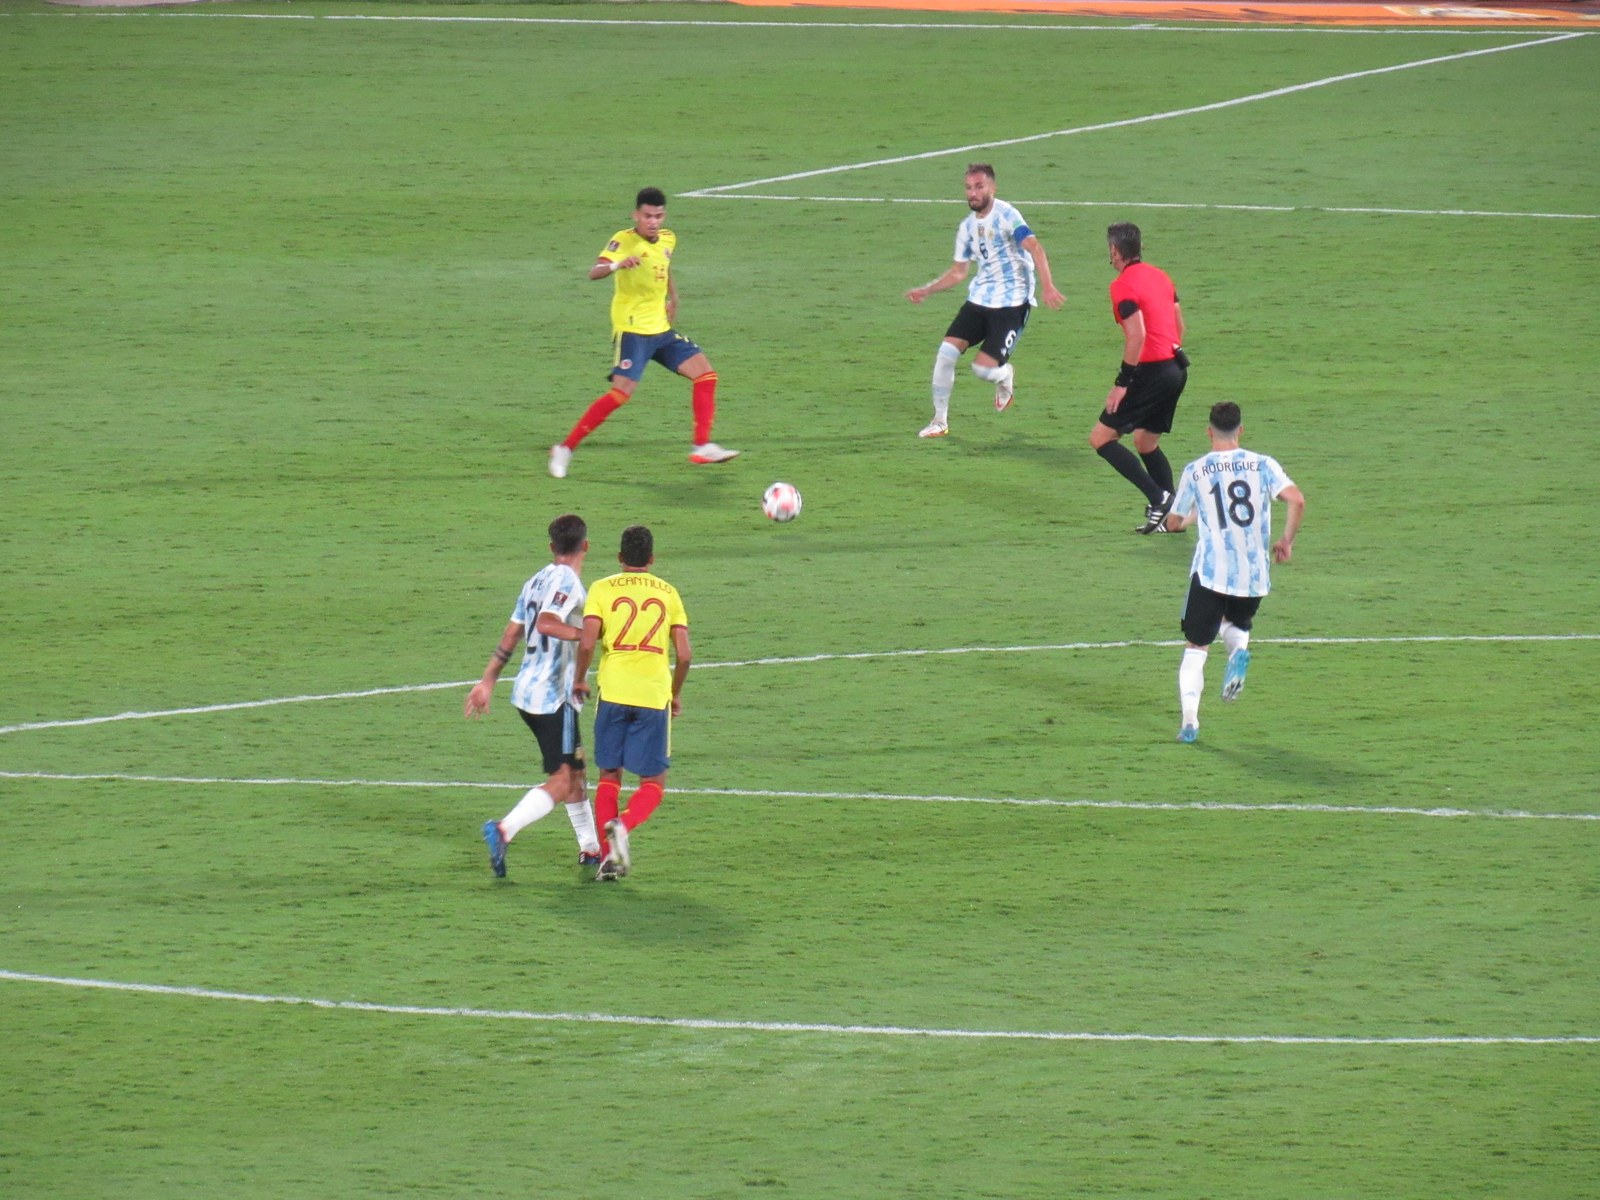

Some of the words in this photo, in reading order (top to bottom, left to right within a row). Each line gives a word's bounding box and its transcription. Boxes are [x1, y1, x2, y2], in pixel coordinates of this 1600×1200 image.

[1005, 329, 1017, 348] 6
[1208, 480, 1255, 530] 18
[611, 596, 666, 655] 22
